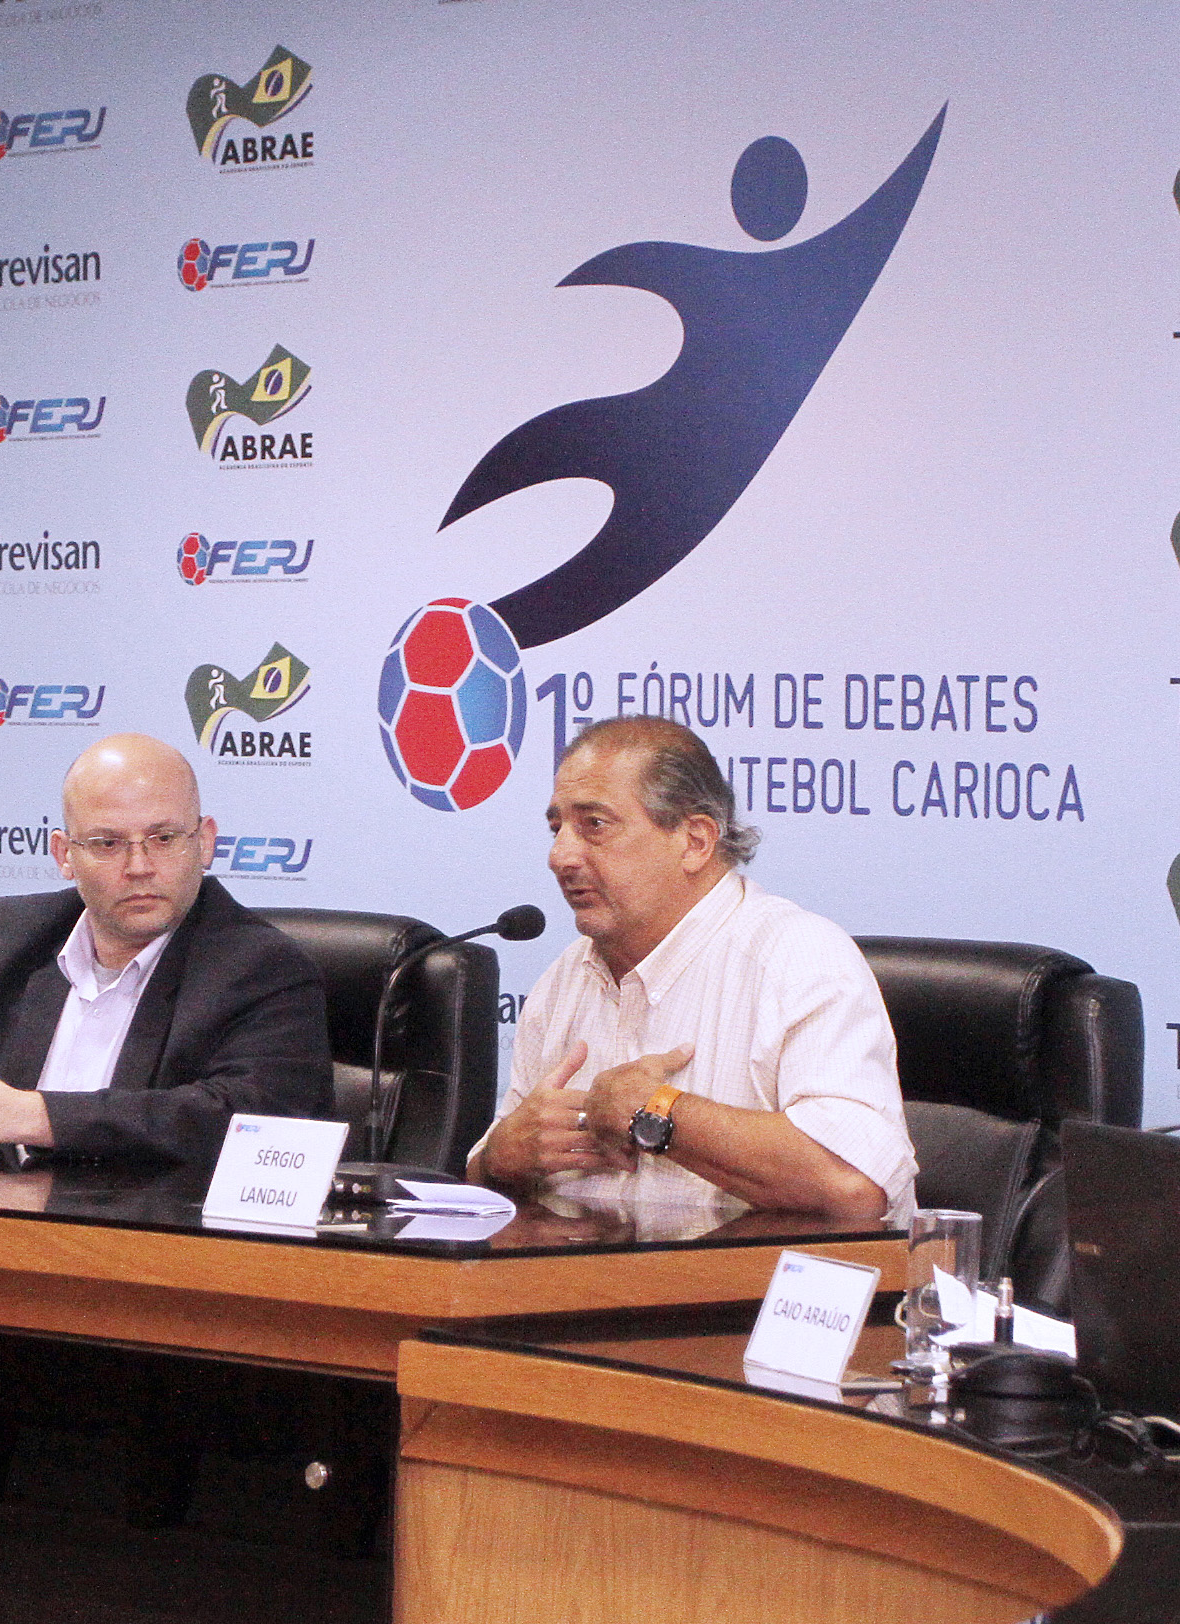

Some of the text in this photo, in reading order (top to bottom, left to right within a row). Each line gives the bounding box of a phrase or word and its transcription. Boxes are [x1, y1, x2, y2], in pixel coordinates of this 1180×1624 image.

[220, 132, 314, 166] ABRAE
[220, 432, 313, 461] ABRAE
[618, 661, 754, 728] FÓRUM
[774, 673, 824, 729] DE
[845, 674, 1038, 733] DEBATES
[219, 731, 311, 757] ABRAE
[723, 757, 1085, 822] TEBOL CARIOCA
[254, 1145, 305, 1169] SÉRGIO
[240, 1186, 298, 1207] LANDAU
[773, 1298, 850, 1332] CAIO ARAÚJO
